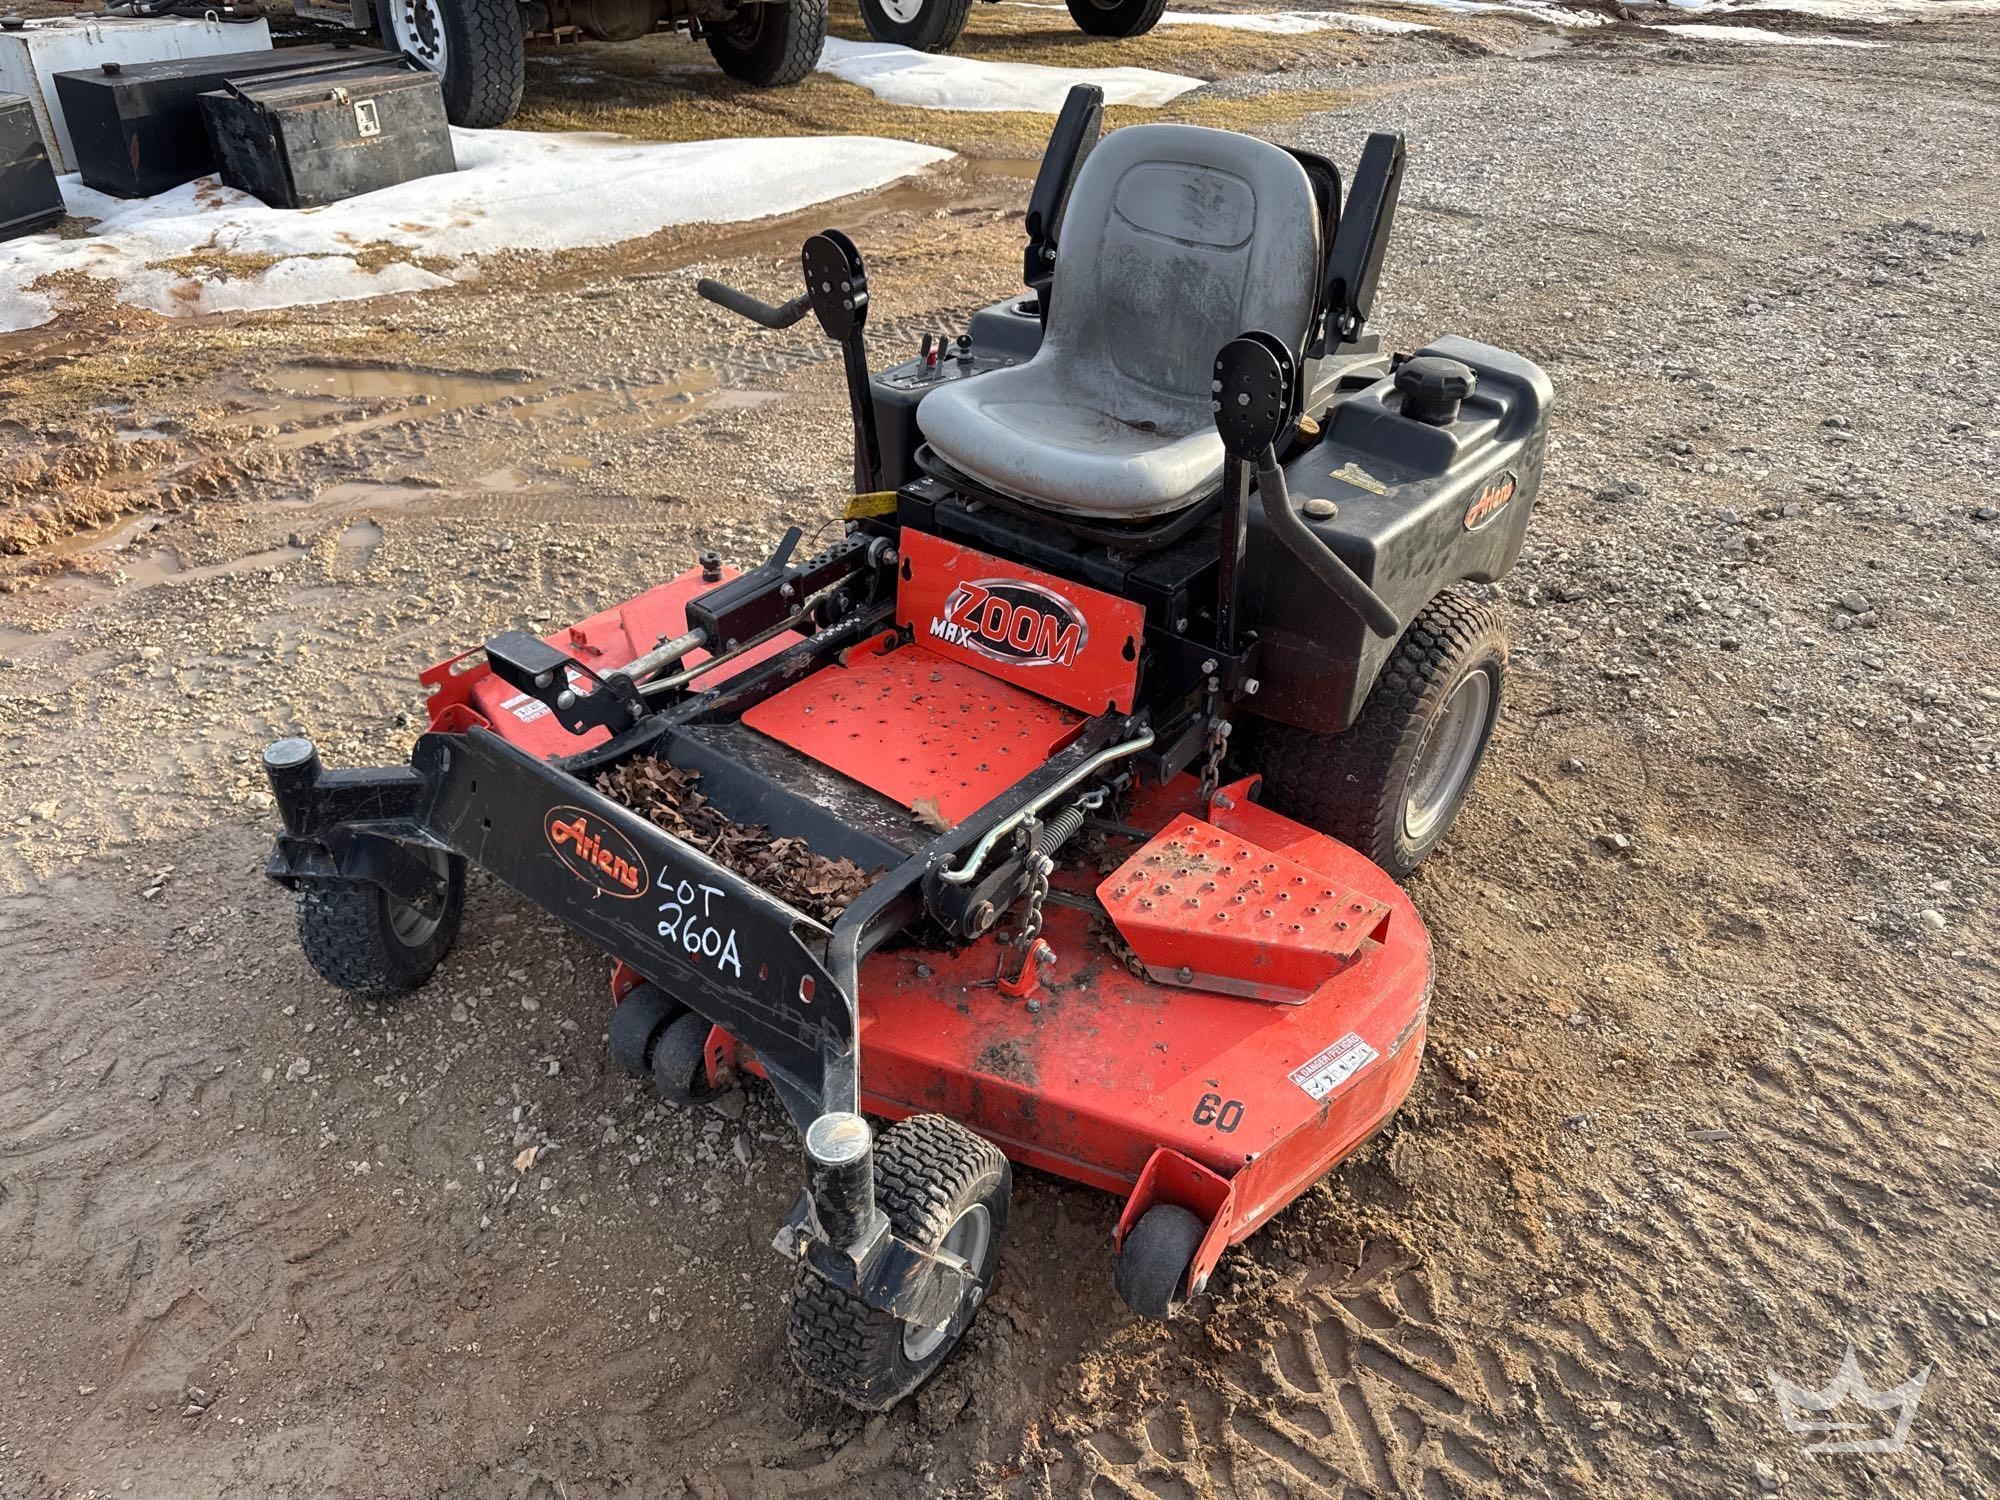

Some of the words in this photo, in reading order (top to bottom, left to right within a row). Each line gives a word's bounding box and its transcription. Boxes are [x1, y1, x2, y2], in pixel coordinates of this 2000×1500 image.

[929, 616, 972, 649] MAX
[949, 580, 1081, 667] ZOOM
[551, 817, 637, 891] Ariens
[656, 865, 726, 918] LOT
[658, 901, 742, 978] 260A
[1300, 1035, 1360, 1079] DANGER/PELIGRO
[1192, 1093, 1245, 1134] 60
